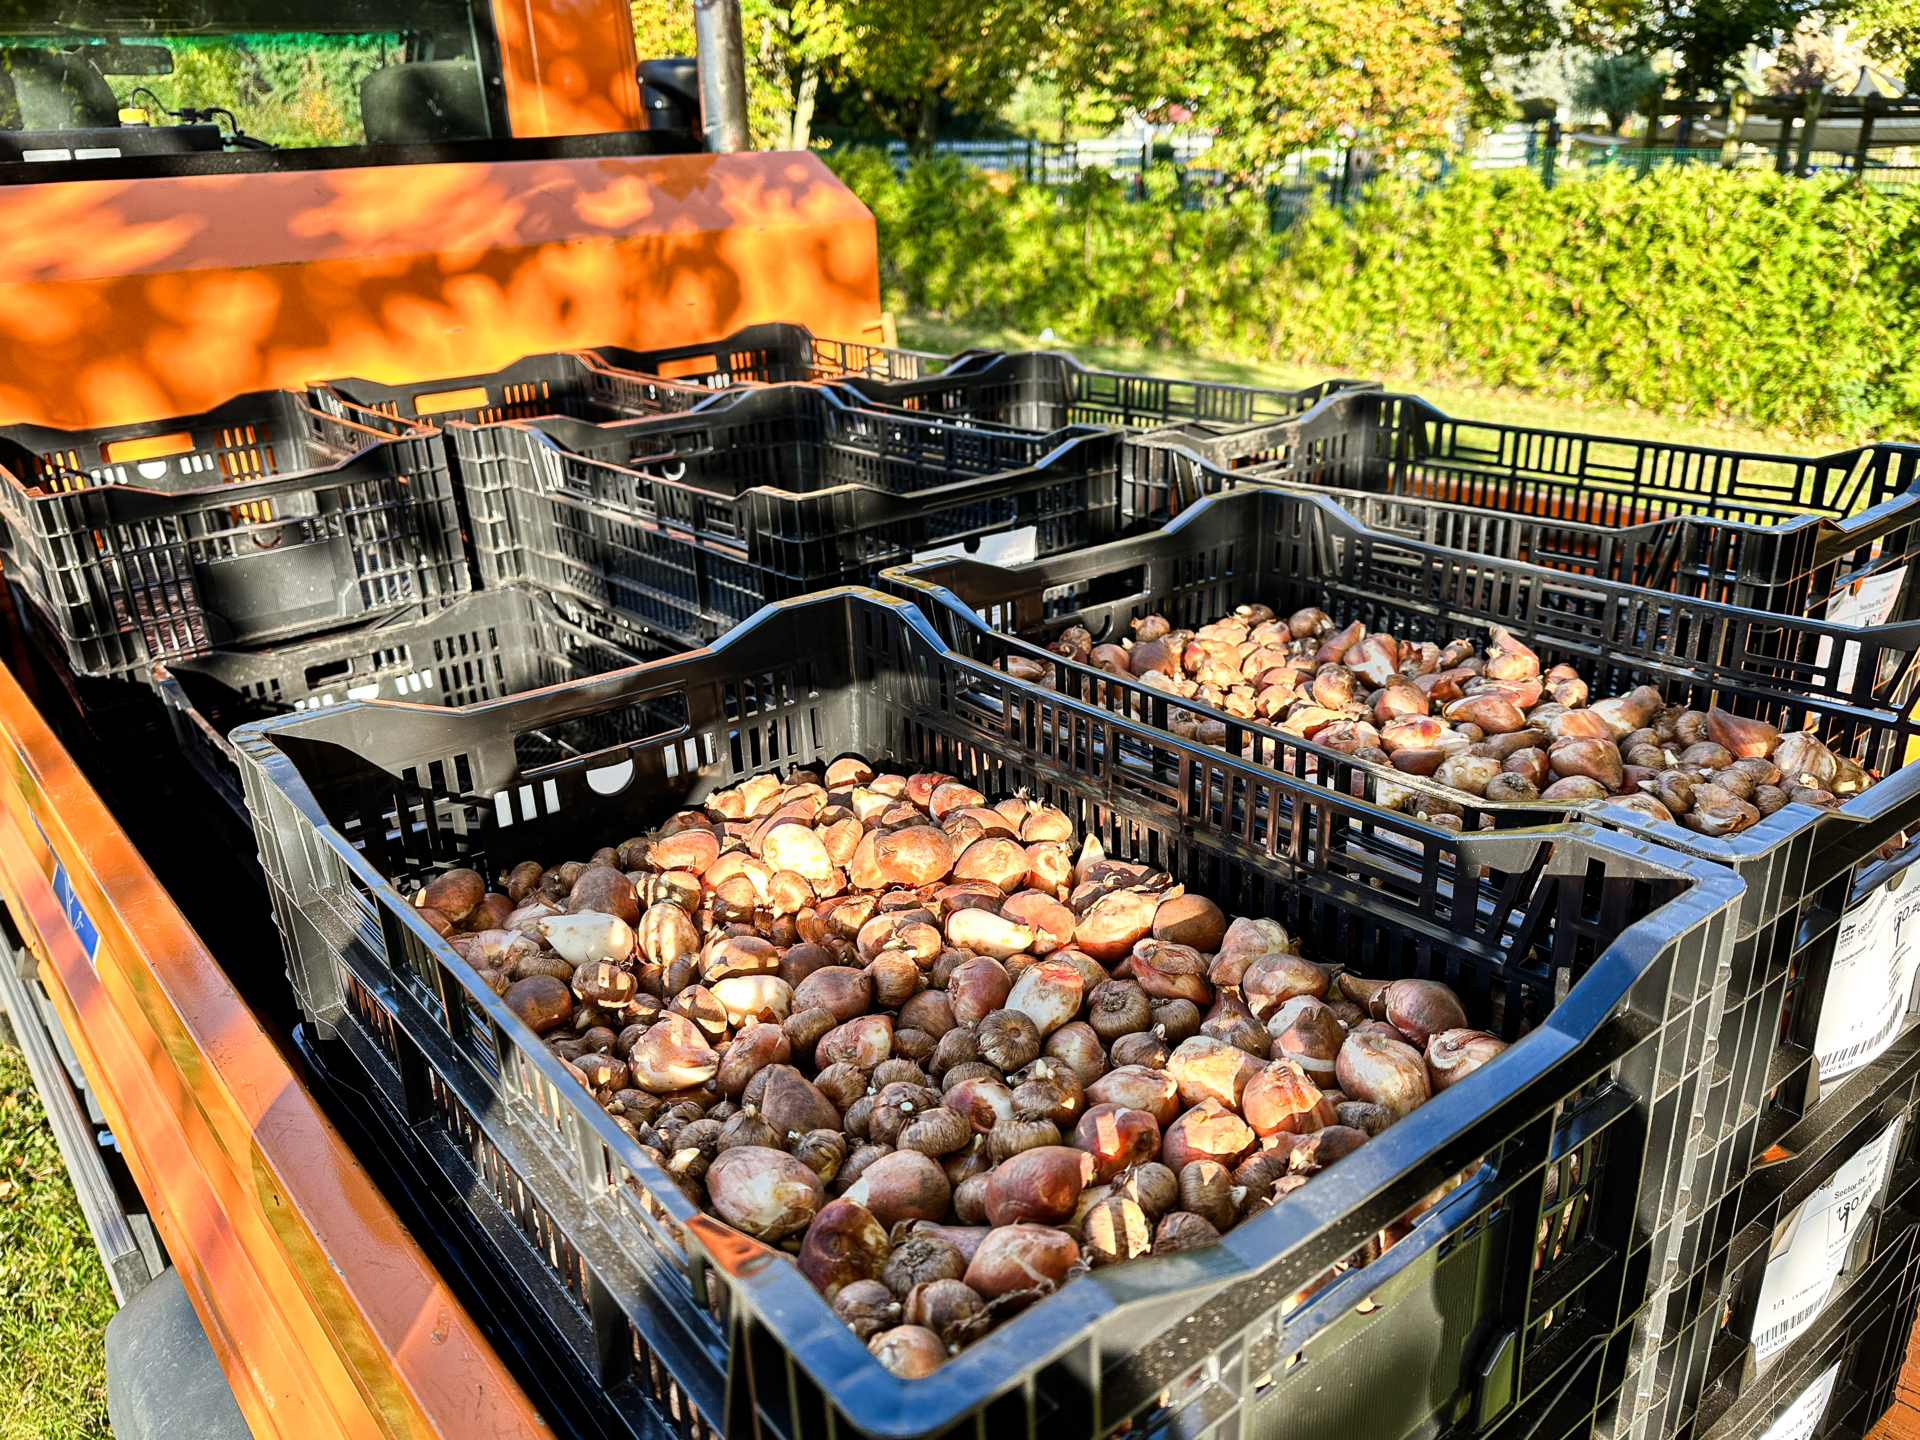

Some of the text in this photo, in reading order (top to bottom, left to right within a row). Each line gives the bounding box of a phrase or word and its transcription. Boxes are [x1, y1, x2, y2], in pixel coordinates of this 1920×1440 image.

[1834, 1182, 1857, 1199] Sector
[1772, 1298, 1786, 1311] 1/1
[1773, 1334, 1788, 1347] krat
